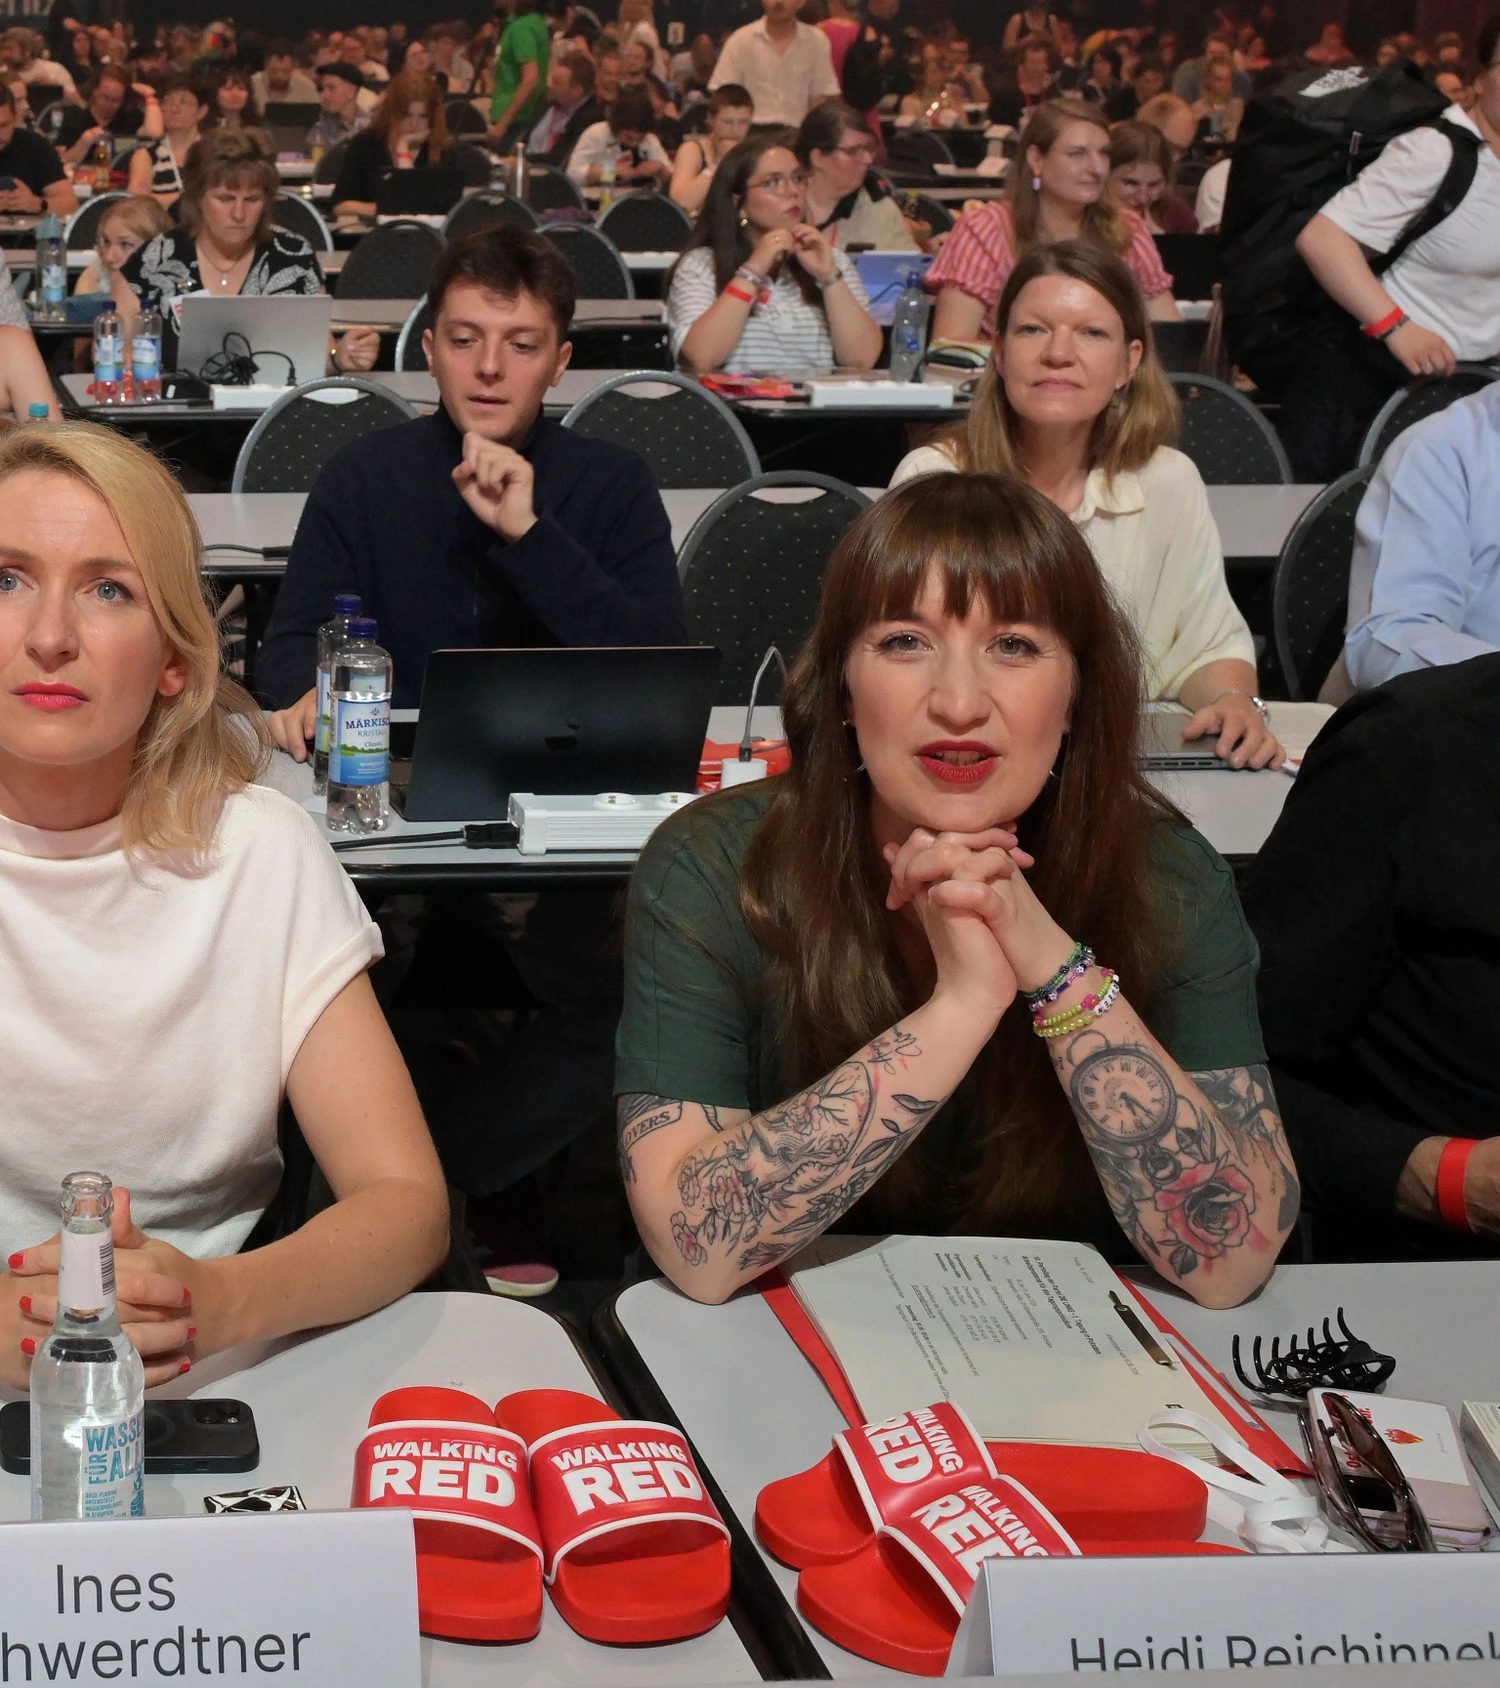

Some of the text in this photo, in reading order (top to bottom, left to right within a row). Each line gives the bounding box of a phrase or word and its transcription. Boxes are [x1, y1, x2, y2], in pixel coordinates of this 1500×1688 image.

[84, 1453, 108, 1485] FÜR
[373, 1441, 518, 1472] WALKING
[550, 1441, 688, 1472] WALKING
[861, 1413, 934, 1484] RED
[369, 1459, 515, 1508] RED
[559, 1459, 703, 1516] RED
[55, 1563, 176, 1615] Ines
[1070, 1634, 1205, 1672] Heidi
